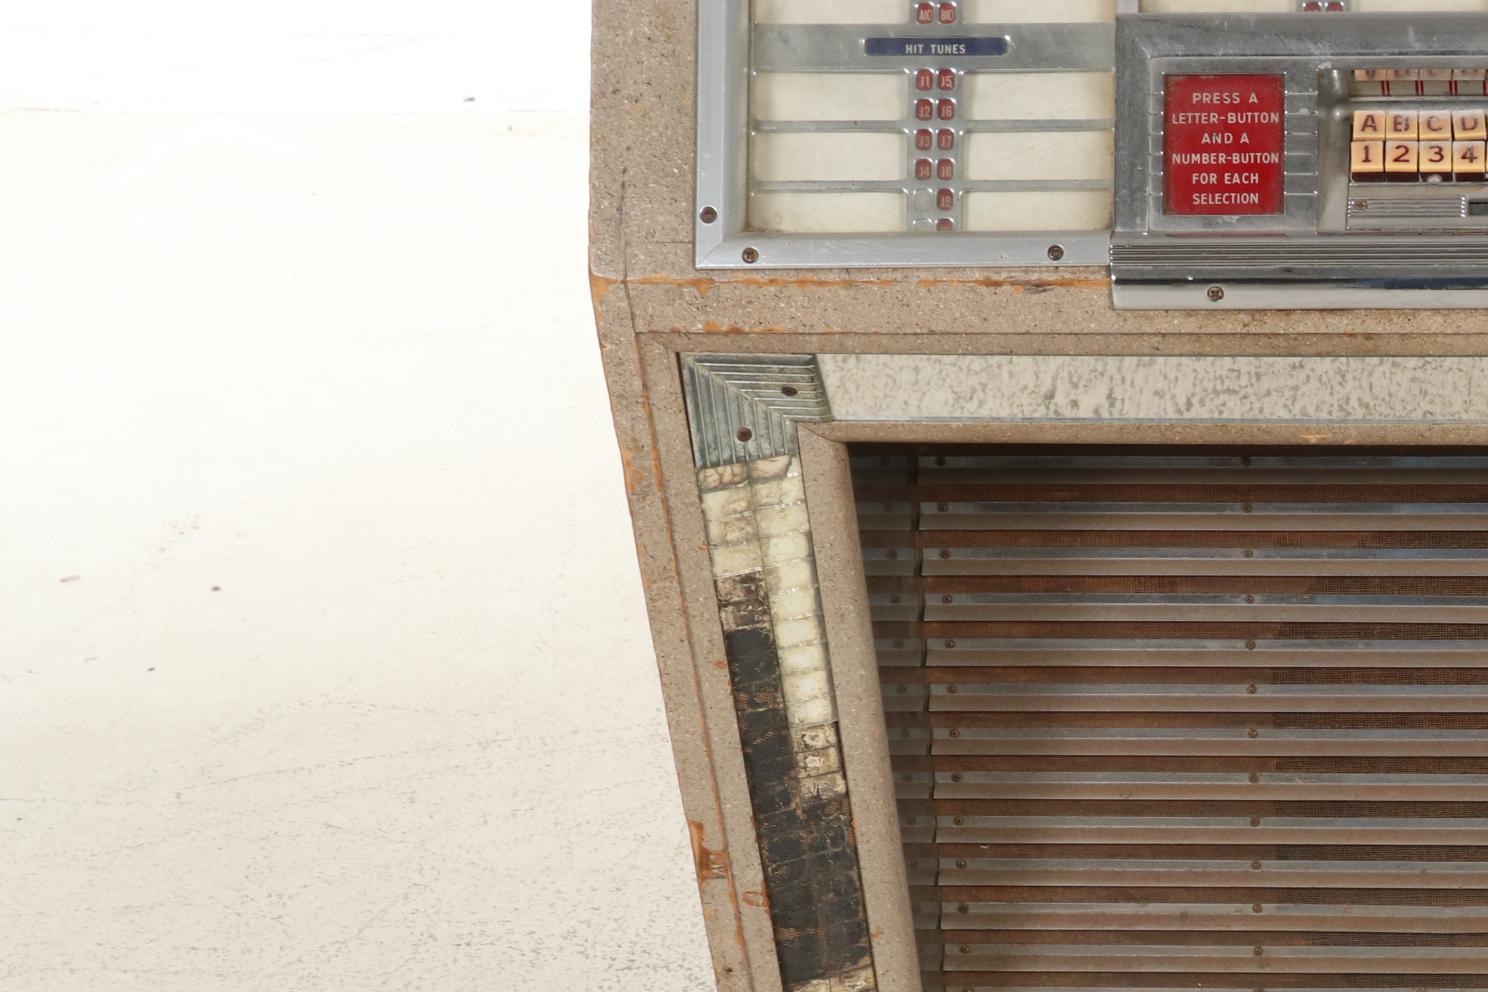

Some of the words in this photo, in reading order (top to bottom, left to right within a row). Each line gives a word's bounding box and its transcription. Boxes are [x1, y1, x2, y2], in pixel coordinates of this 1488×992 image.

[919, 10, 932, 21] A10
[905, 44, 924, 54] HIT
[930, 44, 966, 54] TUNES
[1192, 92, 1241, 104] PRESS
[1248, 92, 1258, 103] A
[1172, 112, 1279, 124] LETTER-BUTTON
[1360, 114, 1377, 132] A
[1393, 115, 1410, 132] B
[1426, 116, 1443, 132] C
[1461, 116, 1478, 131] D
[1201, 133, 1233, 144] AND
[1239, 133, 1250, 144] A
[1171, 153, 1279, 165] NUMBER-BUTTON
[1361, 145, 1372, 163] 1
[1392, 145, 1410, 163] 2
[1428, 145, 1445, 163] 3
[1460, 145, 1478, 163] 4
[1192, 173, 1217, 184] FOR
[1224, 172, 1259, 184] EACH
[1192, 193, 1259, 205] SELECTION
